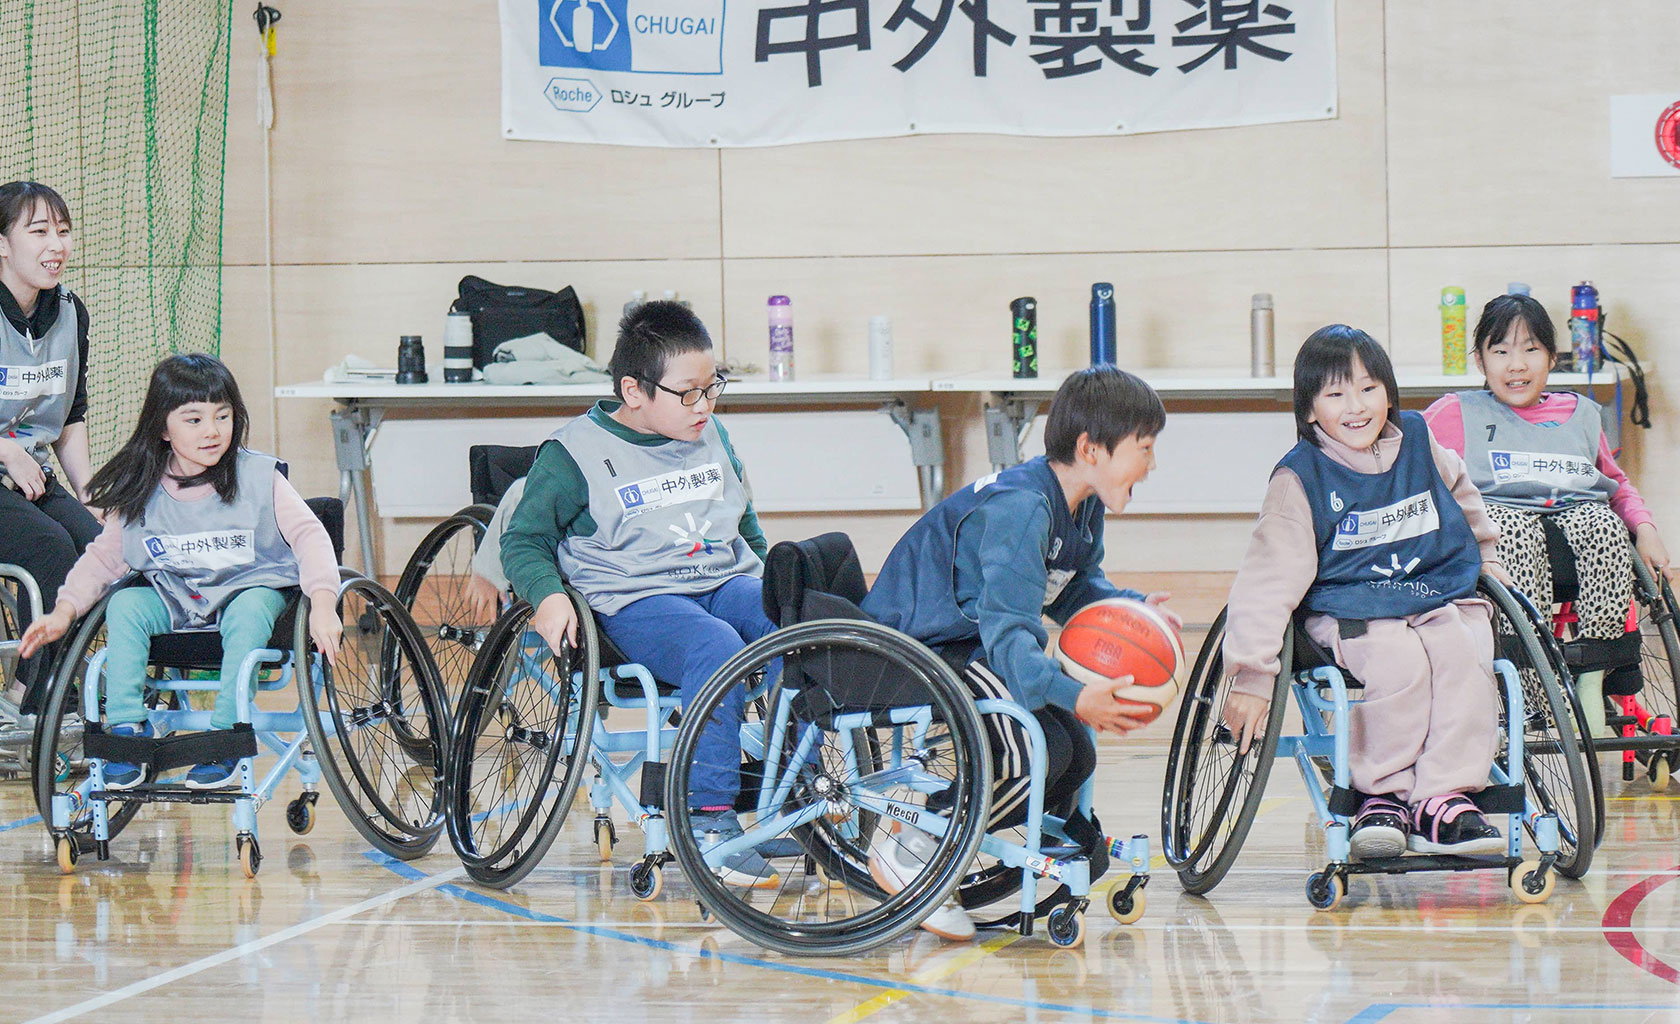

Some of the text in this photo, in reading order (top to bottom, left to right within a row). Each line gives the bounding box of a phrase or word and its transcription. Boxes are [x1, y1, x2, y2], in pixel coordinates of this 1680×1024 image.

[634, 14, 715, 36] CHUGAI
[754, 0, 1296, 88] 中外製薬
[552, 86, 592, 103] Roche
[611, 90, 726, 109] ロシュ グループ
[1486, 424, 1497, 442] 7
[603, 458, 617, 478] 1
[1533, 458, 1595, 477] 中外製薬
[661, 468, 721, 494] 中外製薬
[1330, 490, 1344, 512] 6
[1382, 498, 1429, 526] 中外製薬
[181, 534, 246, 554] 中外製薬
[1047, 536, 1063, 560] 3
